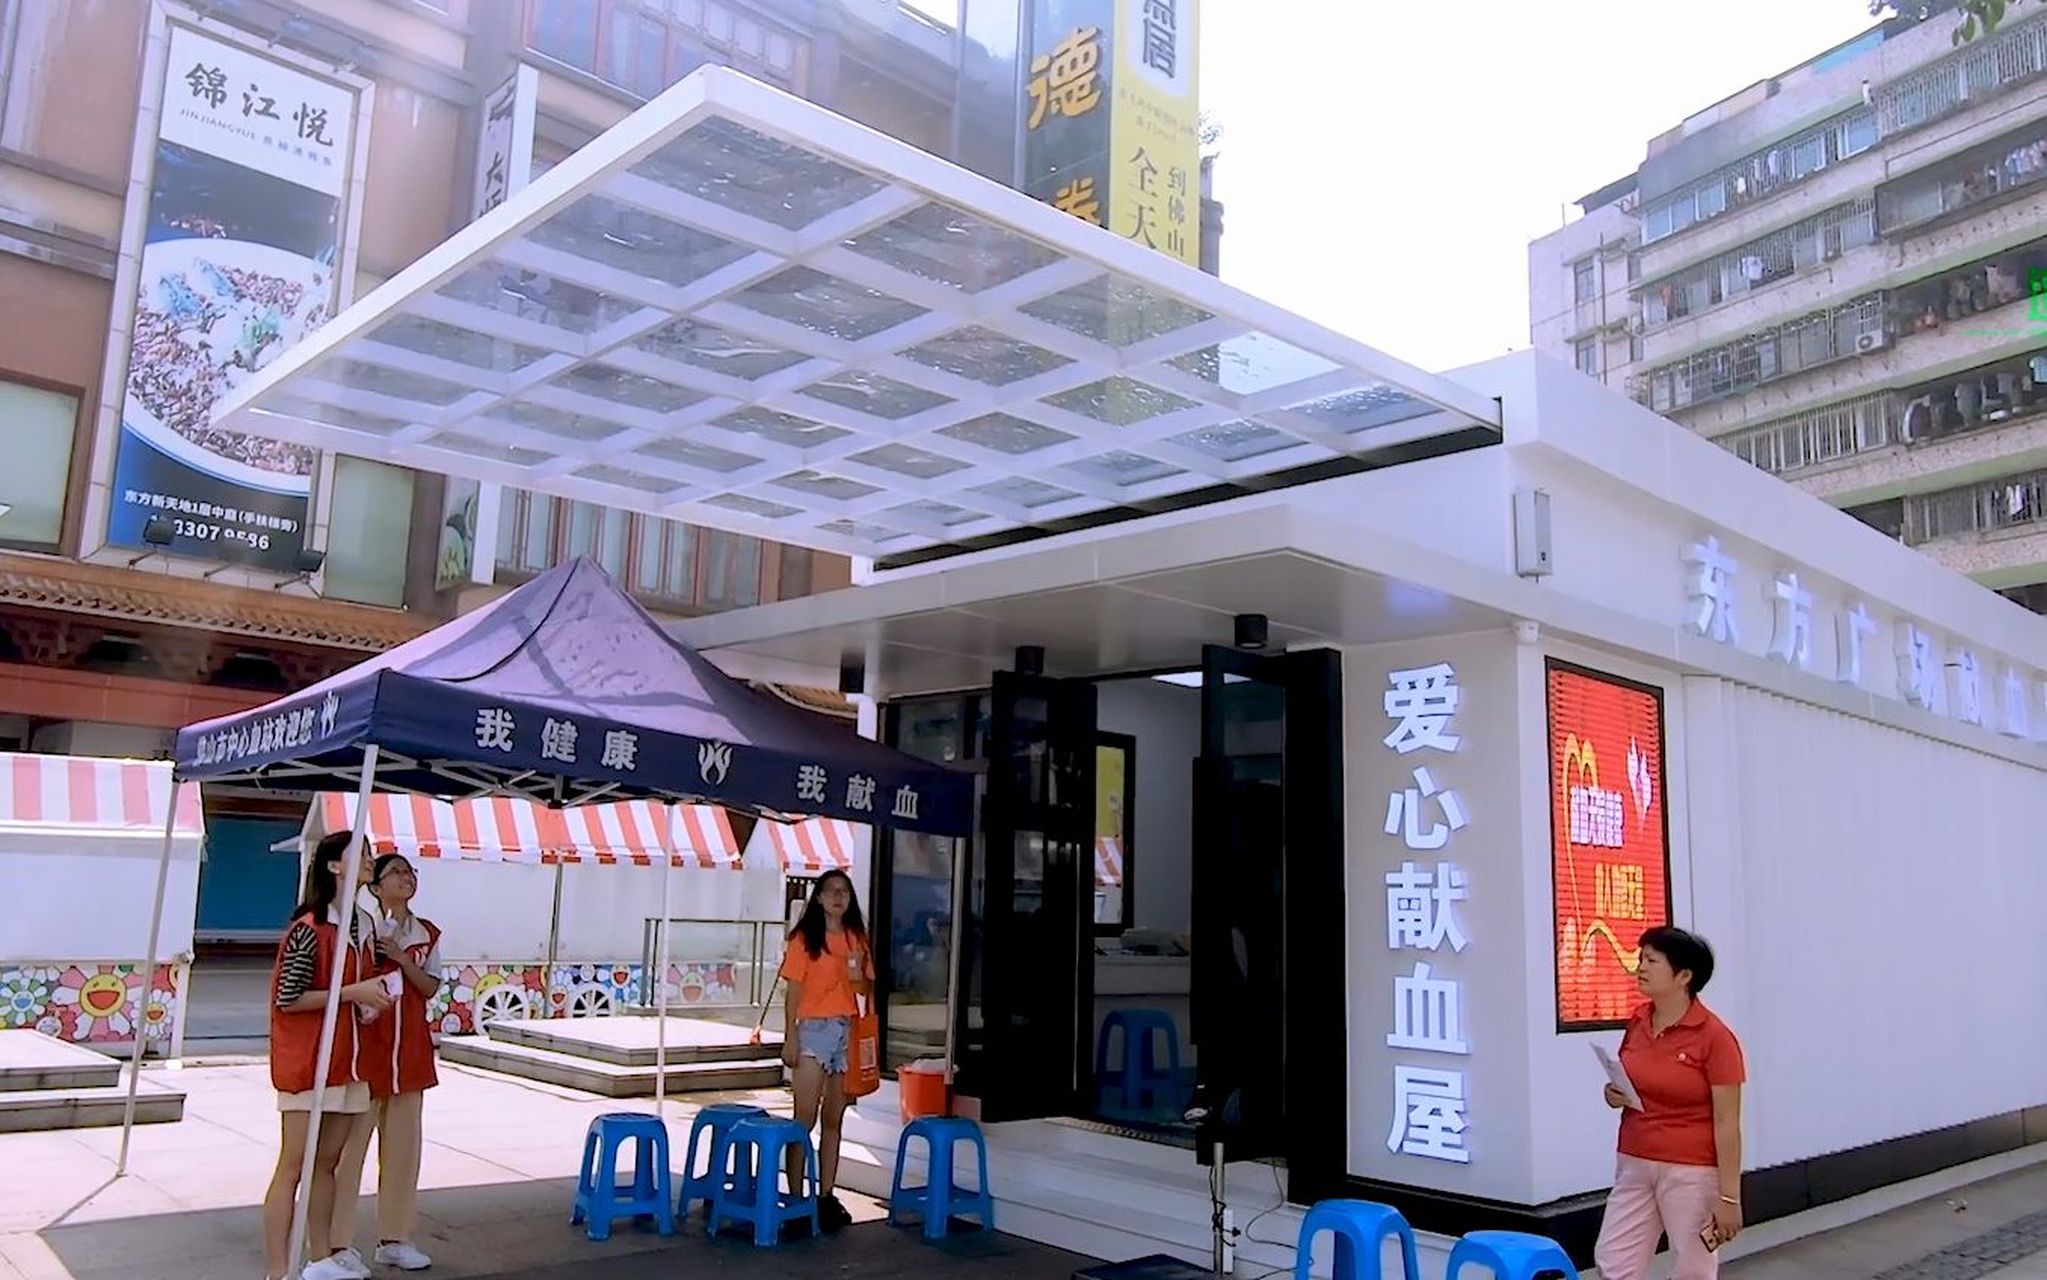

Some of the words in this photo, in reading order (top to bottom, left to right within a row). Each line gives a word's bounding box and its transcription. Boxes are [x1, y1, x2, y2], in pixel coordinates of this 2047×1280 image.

[185, 62, 334, 147] 锦江悦
[1688, 535, 2047, 740] 东方广场献血
[475, 707, 638, 772] 我健康
[797, 763, 920, 821] 我献血
[1383, 663, 1472, 1165] 爱心献血屋
